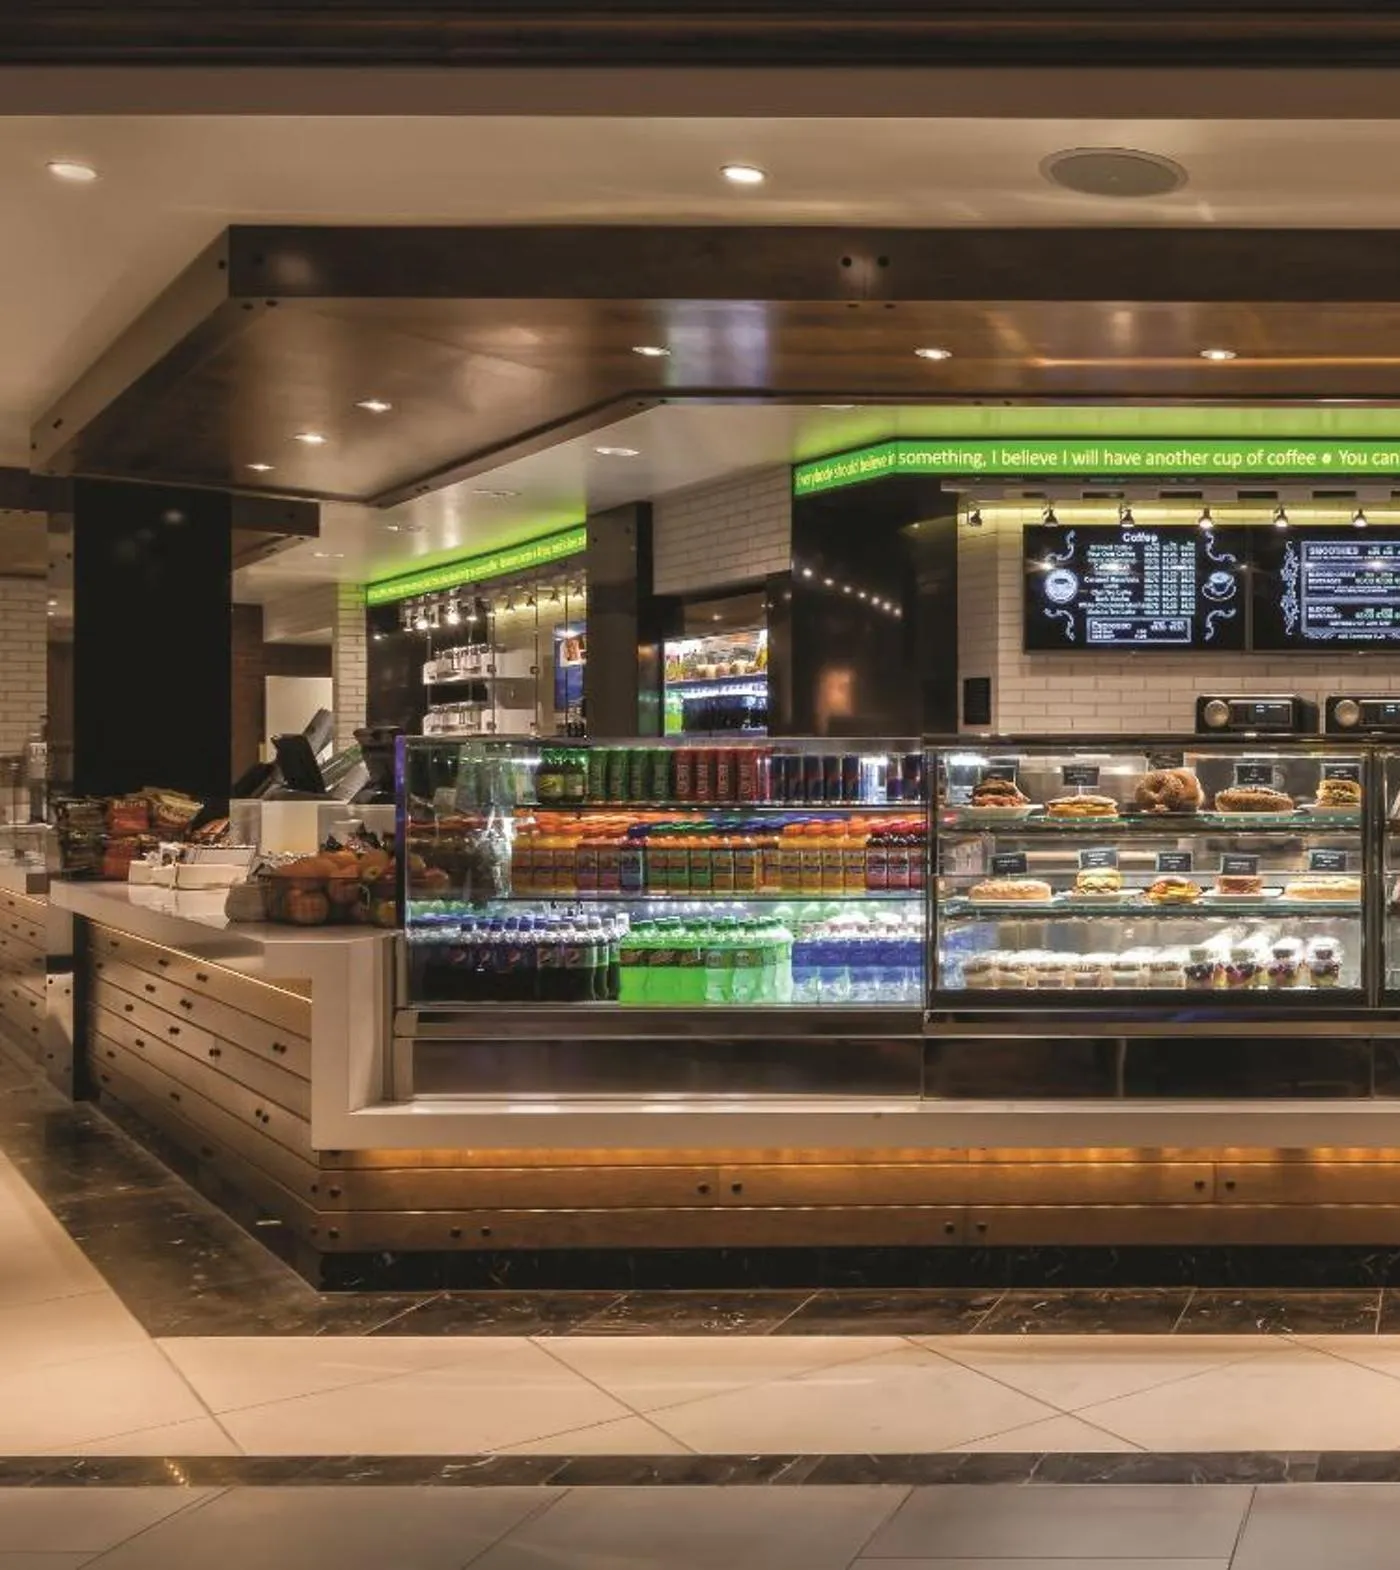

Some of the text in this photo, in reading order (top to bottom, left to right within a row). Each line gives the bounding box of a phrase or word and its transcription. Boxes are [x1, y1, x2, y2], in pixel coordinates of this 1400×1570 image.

[898, 449, 987, 470] something,
[1001, 449, 1058, 466] believe
[1071, 449, 1099, 466] will
[1103, 449, 1142, 466] have
[1146, 449, 1209, 466] another
[1212, 452, 1243, 469] cup
[1246, 449, 1264, 466] of
[1266, 449, 1317, 466] coffee
[1338, 450, 1368, 466] You
[1122, 531, 1159, 543] Coffee
